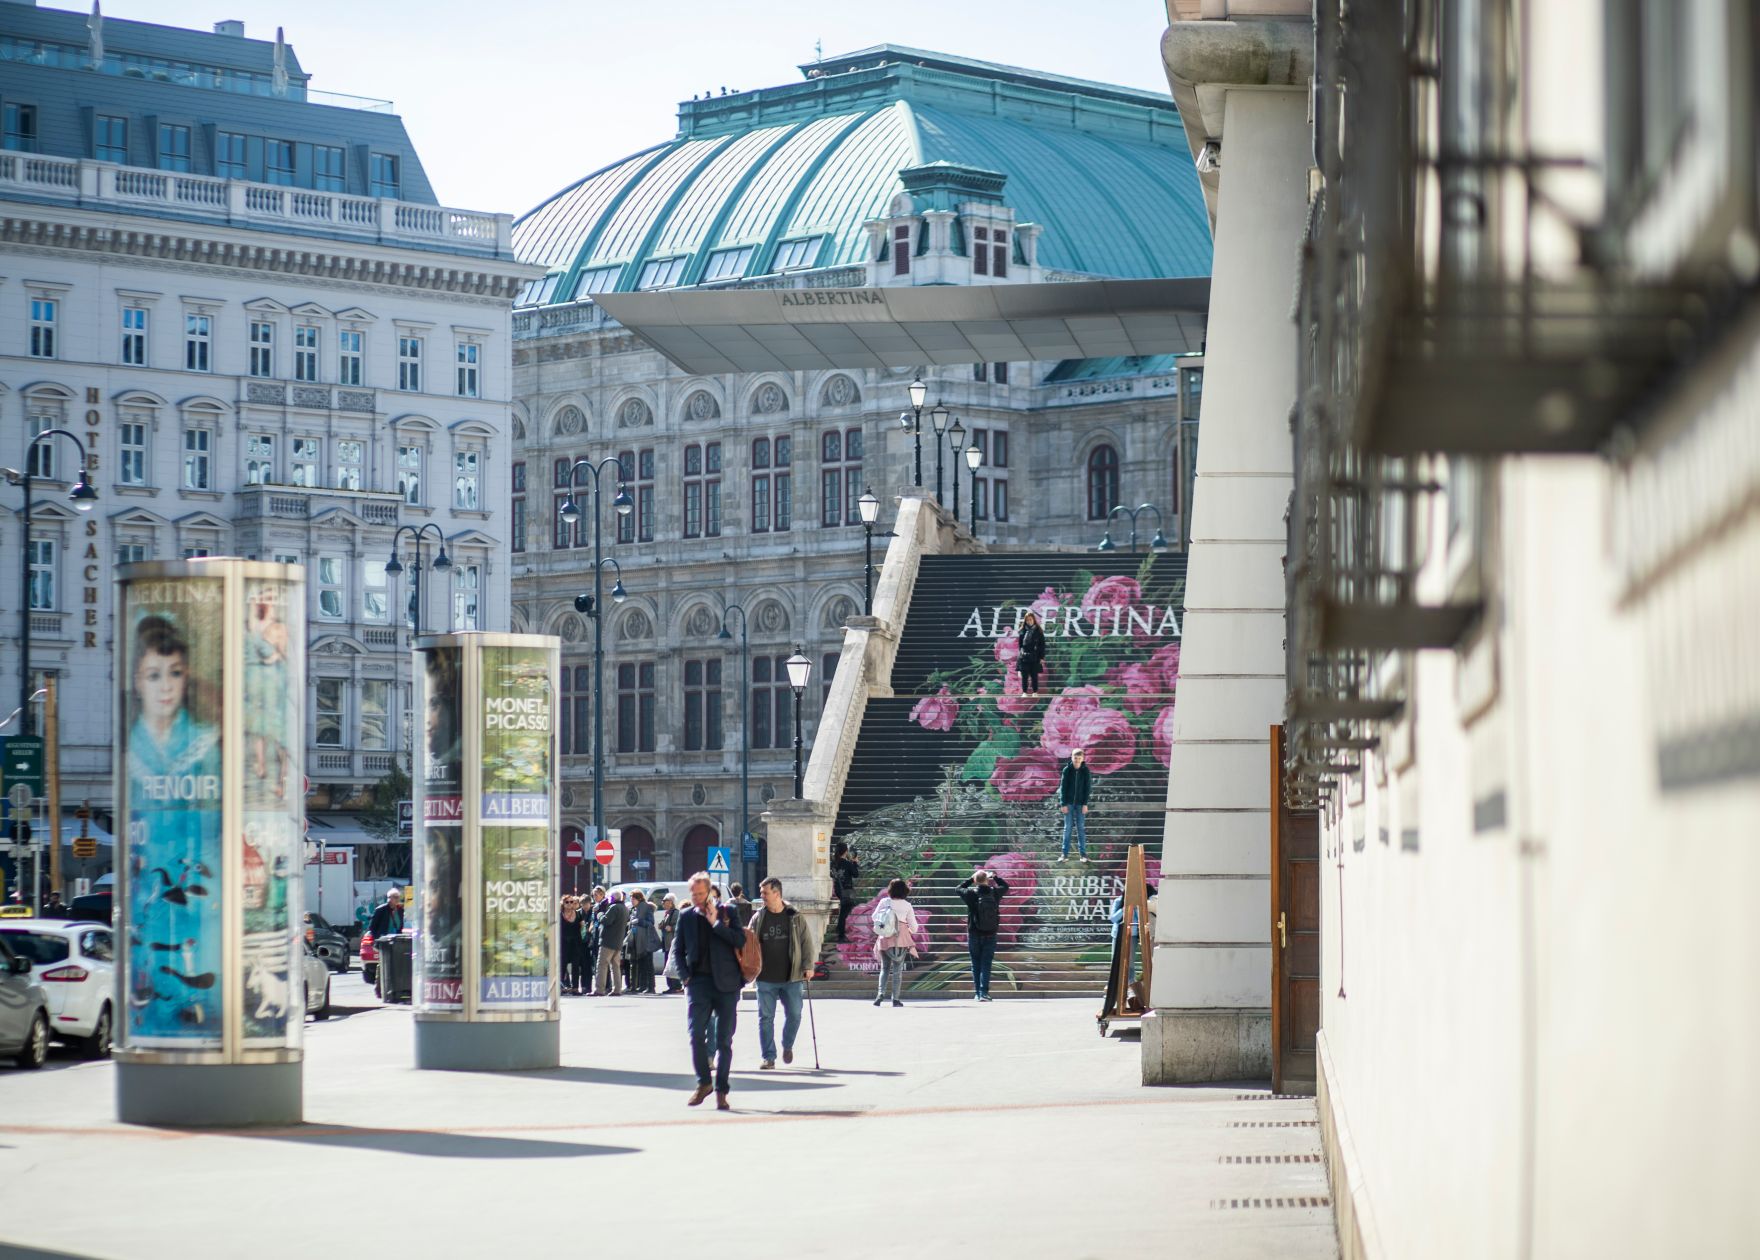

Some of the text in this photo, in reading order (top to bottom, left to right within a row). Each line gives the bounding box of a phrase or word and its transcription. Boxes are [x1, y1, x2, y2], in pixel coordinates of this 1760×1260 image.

[782, 291, 884, 306] ALBERTINA
[84, 520, 97, 648] SACHER
[486, 698, 543, 713] MONET
[486, 714, 548, 731] PICASSO
[143, 775, 220, 800] RENOIR
[486, 881, 543, 896] MONET
[486, 897, 548, 913] PICASSO
